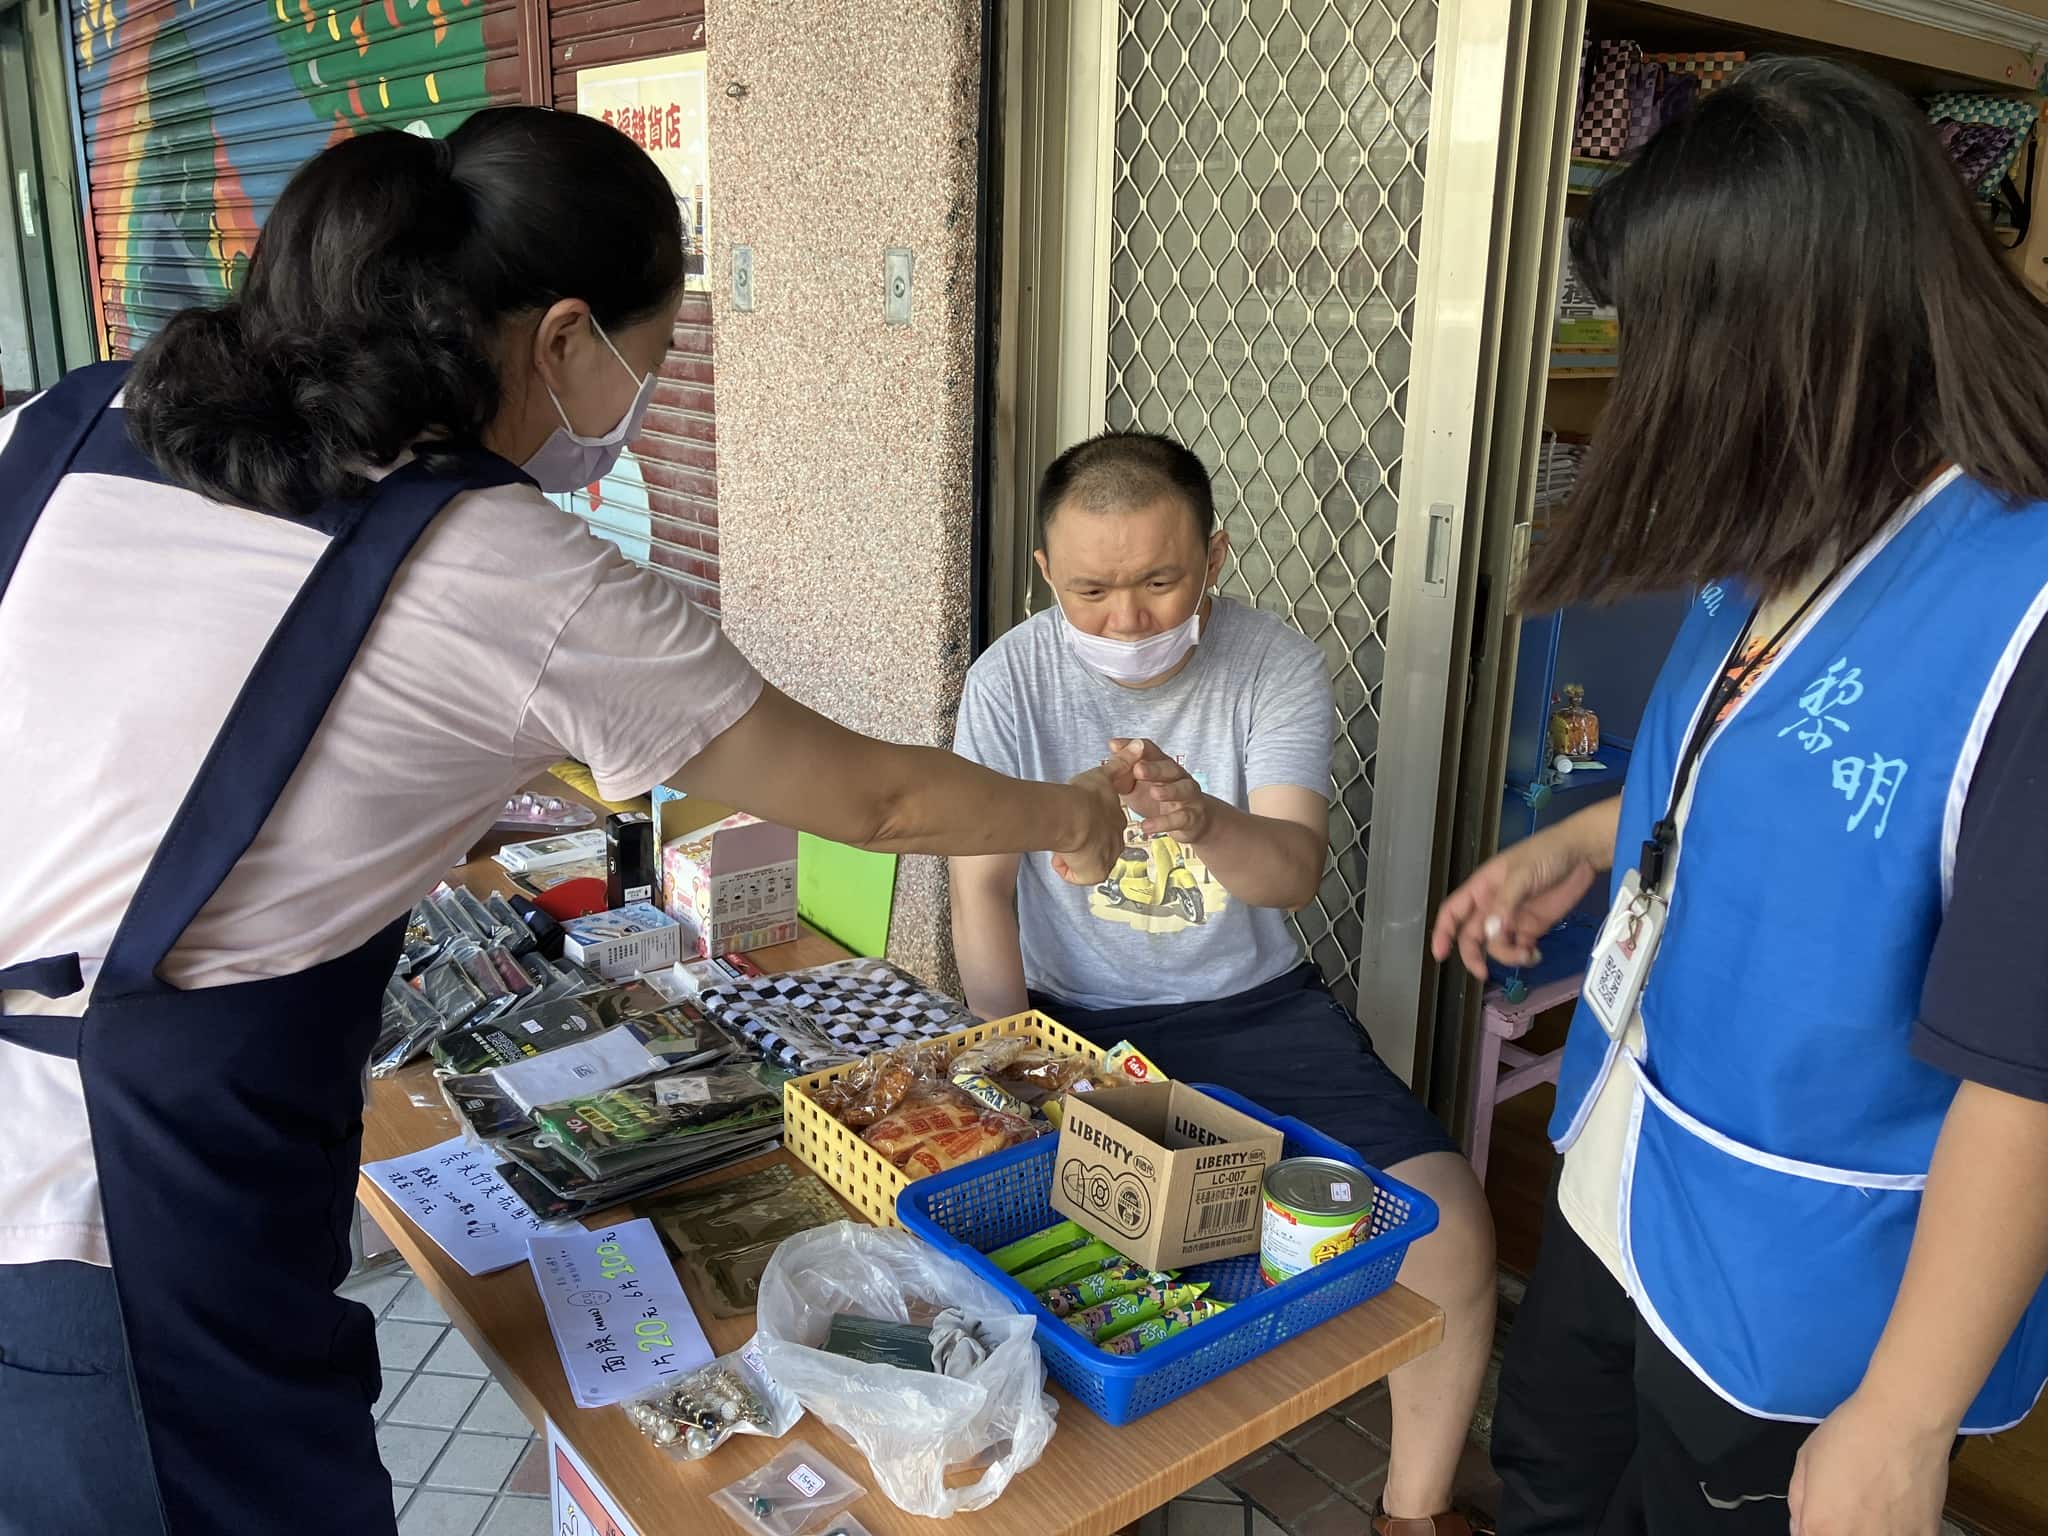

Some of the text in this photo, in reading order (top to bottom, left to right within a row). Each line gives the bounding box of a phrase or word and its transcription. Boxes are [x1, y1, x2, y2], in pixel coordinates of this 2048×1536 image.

[1069, 1115, 1134, 1165] LIBERTY
[1195, 1151, 1248, 1171] LIBERTY
[1212, 1170, 1247, 1186] LC-007
